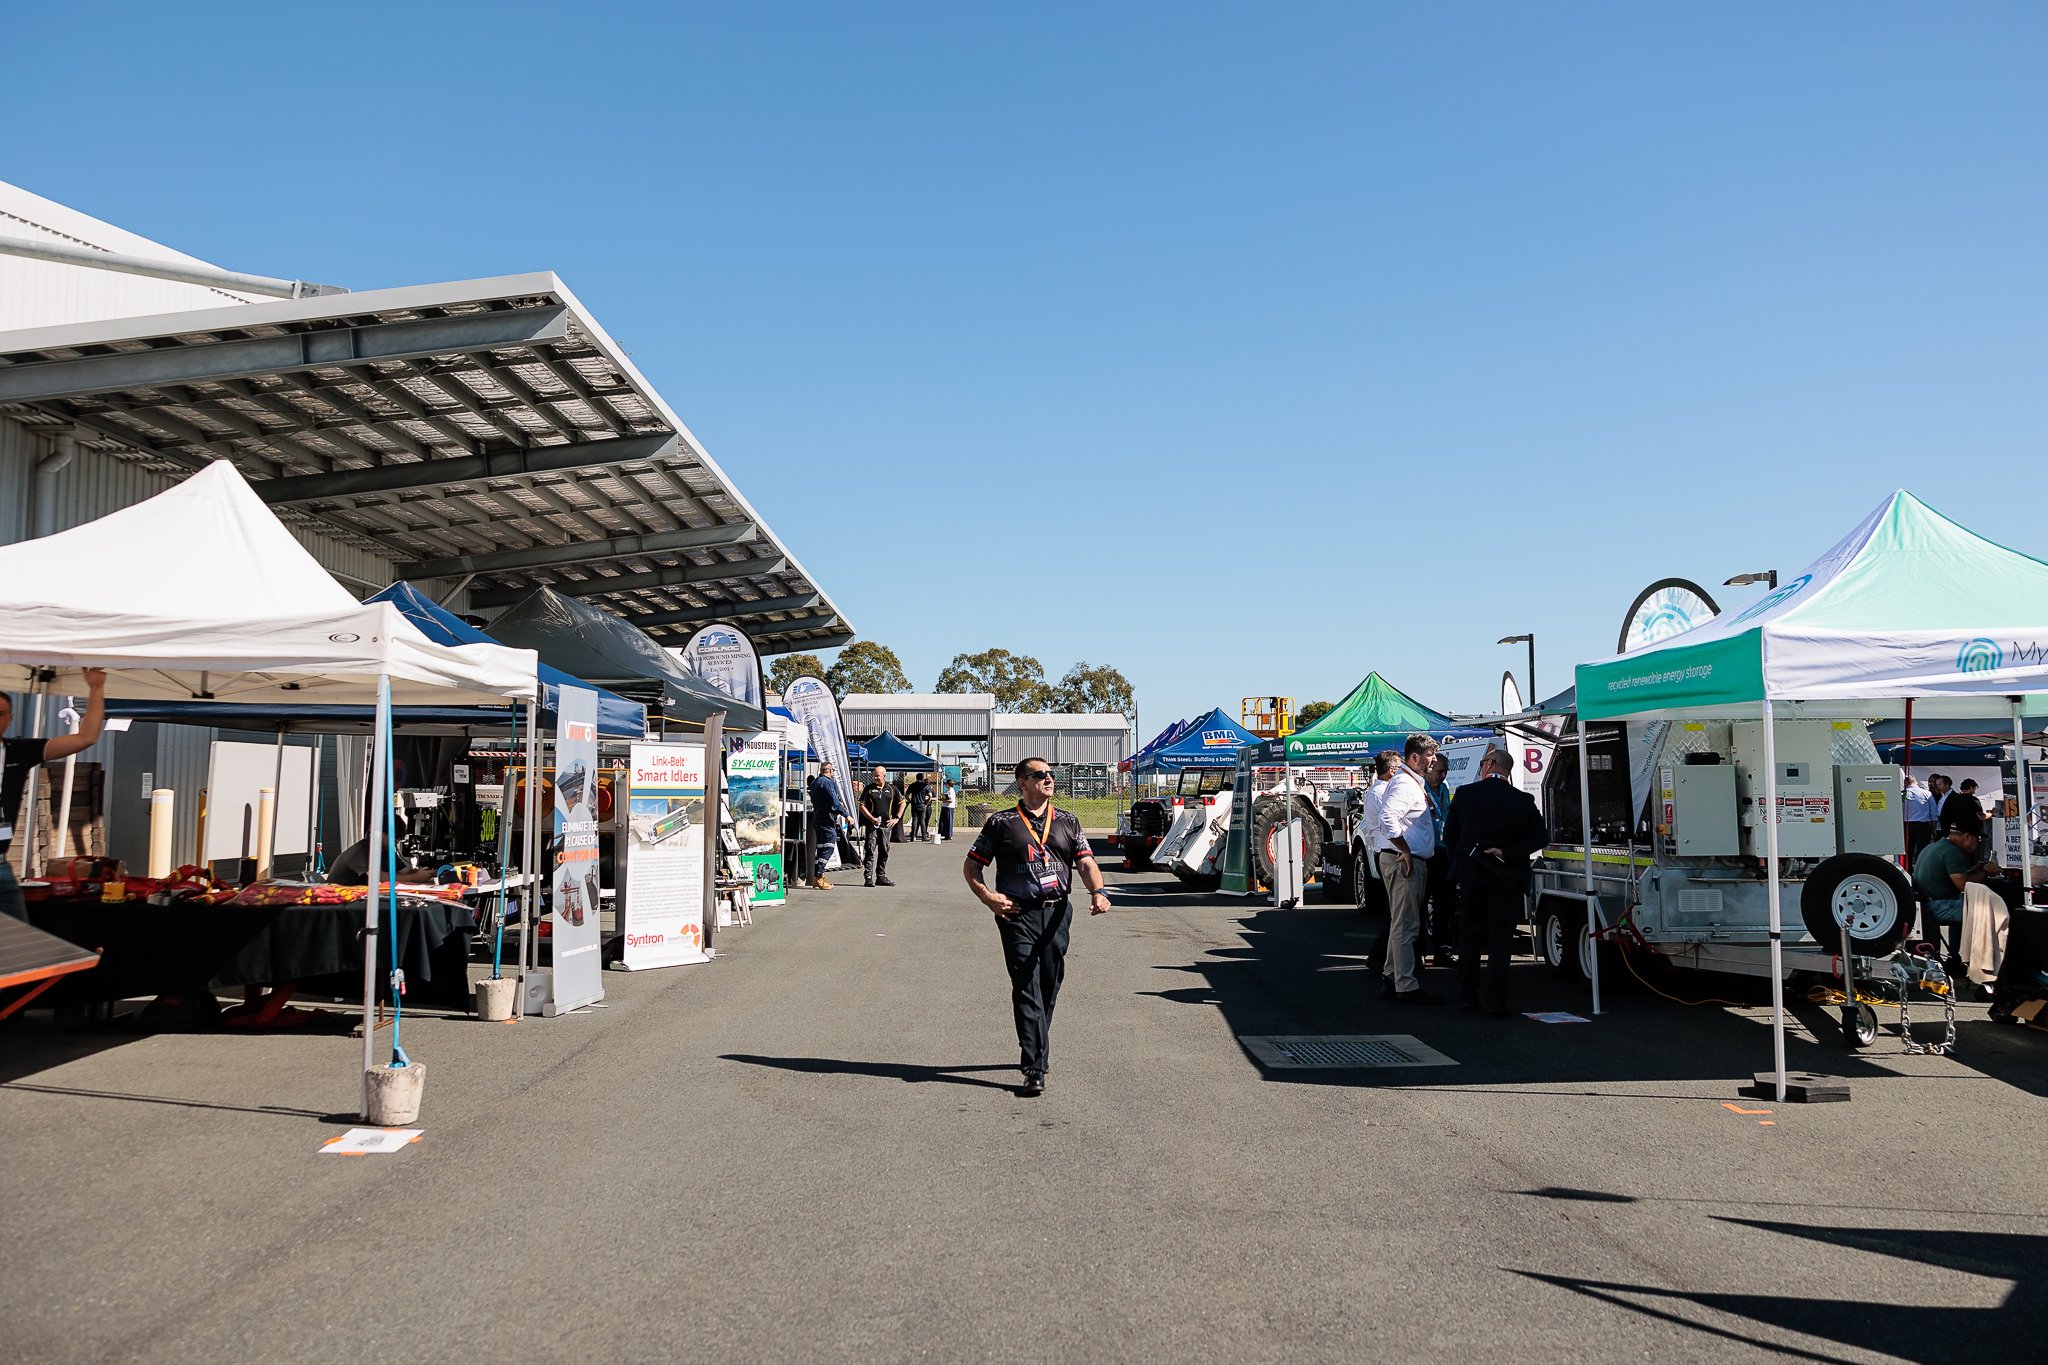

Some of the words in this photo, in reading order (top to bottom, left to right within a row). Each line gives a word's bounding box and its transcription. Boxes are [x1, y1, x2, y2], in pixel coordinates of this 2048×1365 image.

[1607, 676, 1632, 692] recycled
[1631, 671, 1662, 687] renewable
[1662, 669, 1685, 683] energy
[1685, 664, 1712, 679] storage
[1203, 730, 1237, 740] BMA
[729, 736, 744, 753] NB
[744, 741, 777, 750] INDUSTRIES
[1306, 741, 1369, 750] mastermyne
[652, 755, 686, 767] Link-Belt
[731, 759, 776, 768] SY-KLONE
[1642, 750, 1654, 775] recycled
[637, 769, 668, 781] Smart
[670, 769, 698, 782] Idlers
[2004, 799, 2019, 817] IS
[571, 835, 588, 846] CAUSE
[588, 834, 596, 845] OF
[1015, 862, 1064, 873] INDUSRIES
[626, 933, 664, 948] Syntron
